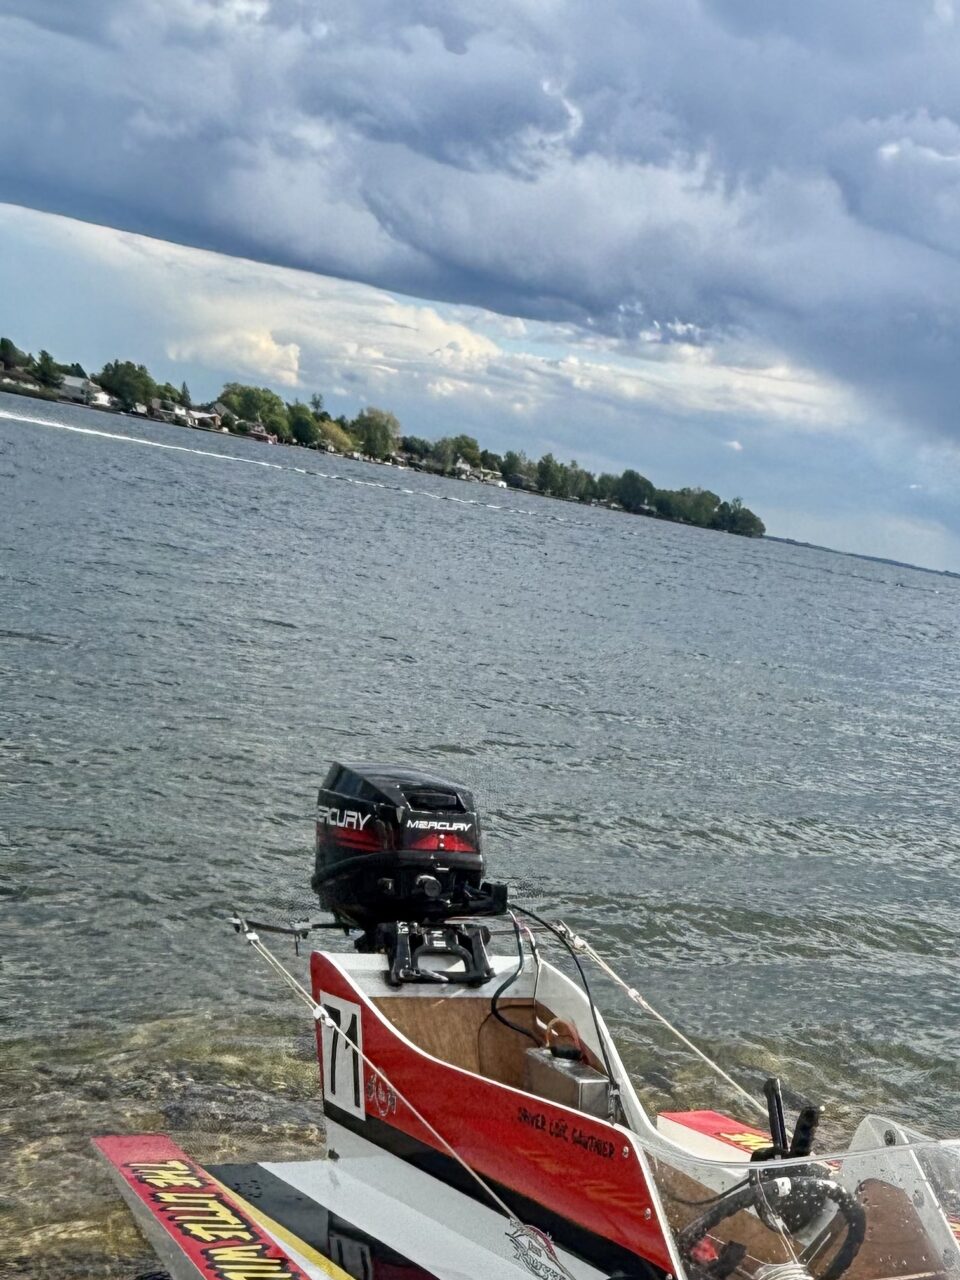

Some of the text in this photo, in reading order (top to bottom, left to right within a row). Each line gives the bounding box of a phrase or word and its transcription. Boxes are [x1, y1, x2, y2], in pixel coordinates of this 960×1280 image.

[318, 805, 371, 831] RCURY
[406, 819, 472, 832] MERCURY
[318, 1003, 361, 1108] 71
[122, 1159, 212, 1189] THE
[150, 1191, 261, 1243] LITTLE
